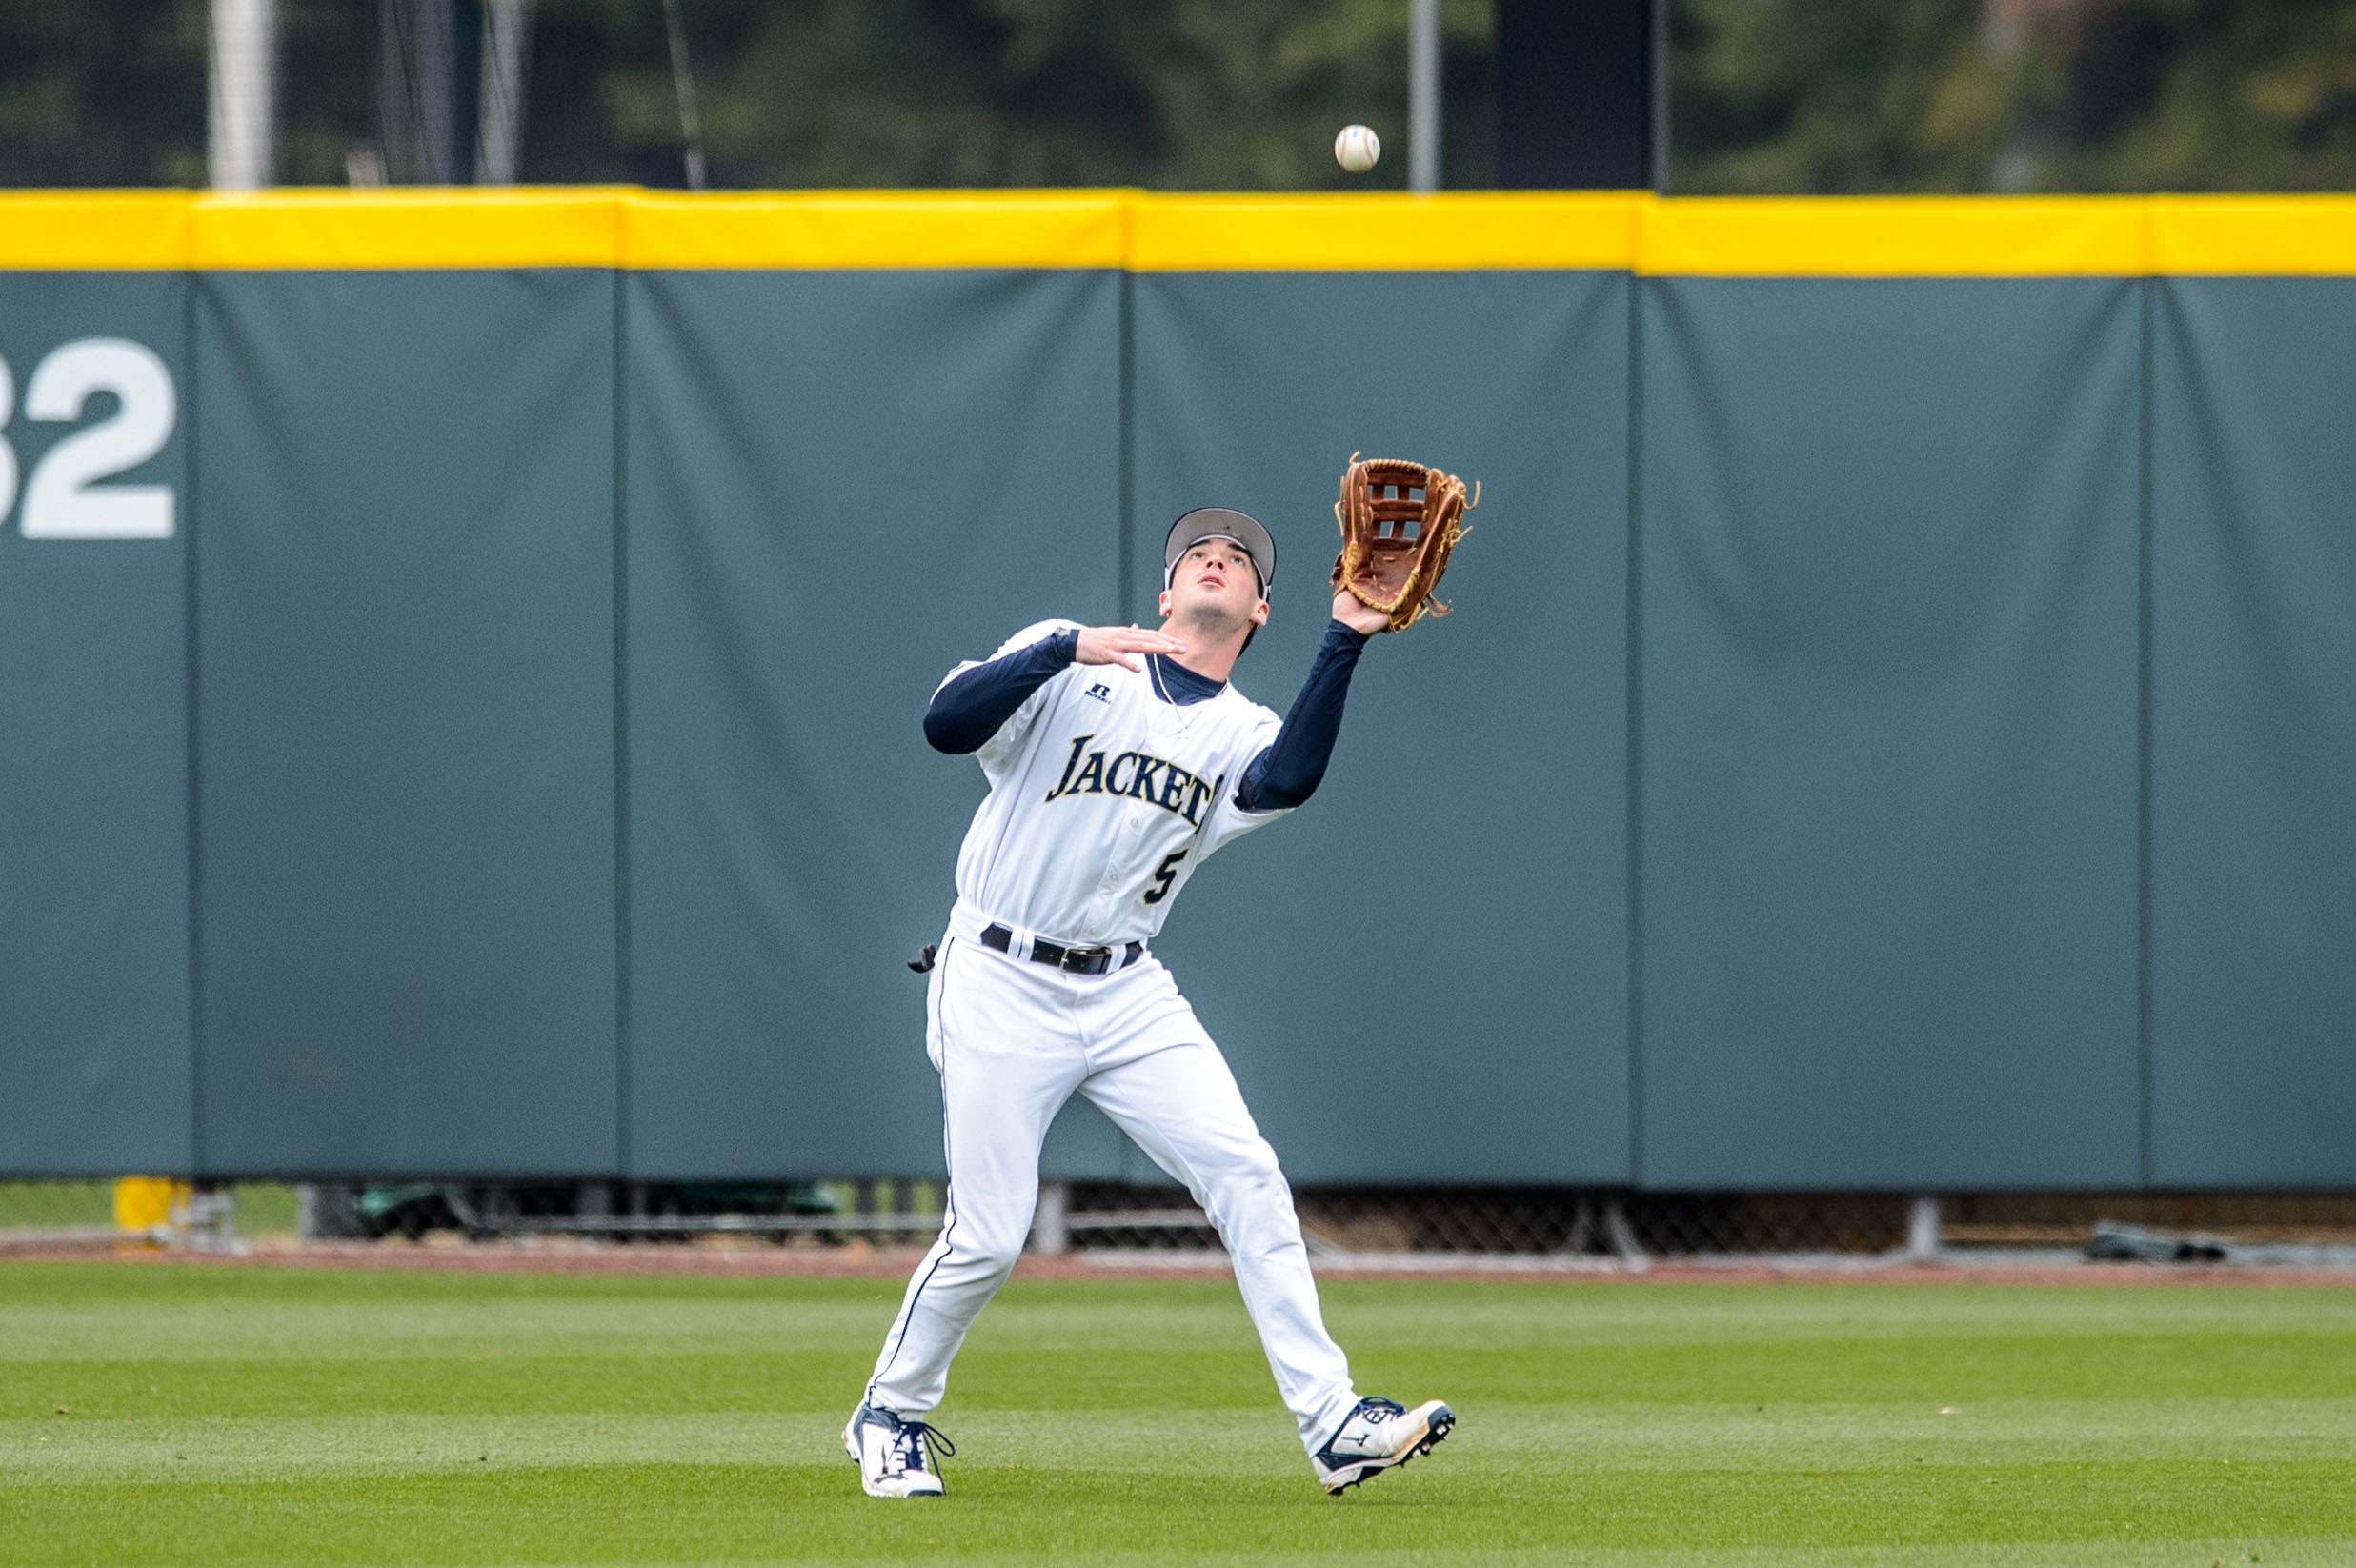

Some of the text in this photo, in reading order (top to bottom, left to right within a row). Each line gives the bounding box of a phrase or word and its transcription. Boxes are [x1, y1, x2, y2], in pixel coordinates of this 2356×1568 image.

[0, 336, 177, 540] 2
[1044, 733, 1224, 834] JACKET
[1142, 848, 1190, 905] 5
